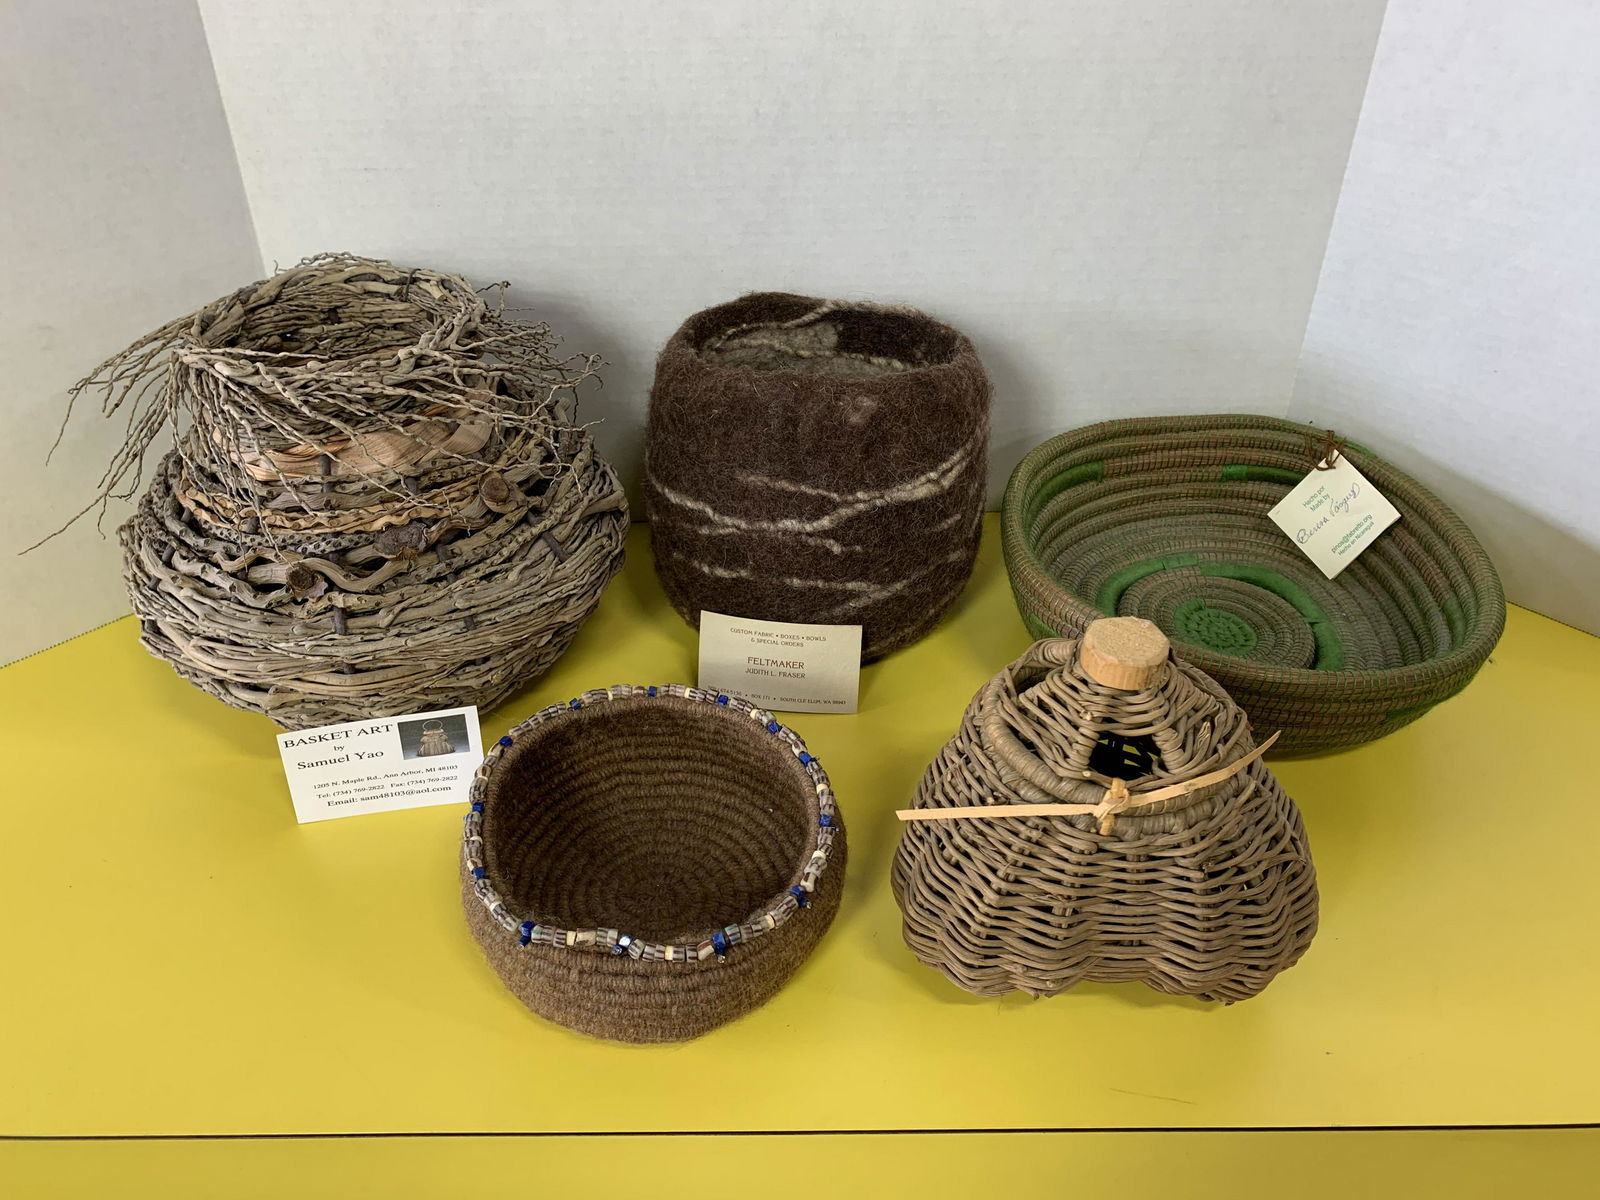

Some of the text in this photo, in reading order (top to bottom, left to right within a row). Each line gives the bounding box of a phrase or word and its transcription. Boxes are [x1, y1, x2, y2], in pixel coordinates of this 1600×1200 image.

[1302, 486, 1326, 508] Hecho por
[1310, 493, 1331, 512] Made by
[1338, 542, 1353, 556] Hecho
[1354, 521, 1374, 542] Nicaragua
[730, 628, 753, 636] CUSTOM
[754, 630, 774, 638] FABRIC
[756, 638, 780, 646] SPECIAL
[748, 656, 804, 670] FELTMAKER
[746, 668, 770, 677] JUDITH
[778, 672, 806, 680] FRASER
[284, 724, 393, 748] BASKET ART
[297, 751, 384, 770] Samuel Yao
[342, 778, 364, 786] Maple
[353, 784, 385, 793] 769-2822
[328, 786, 452, 807] Email: sam48103@aol.com
